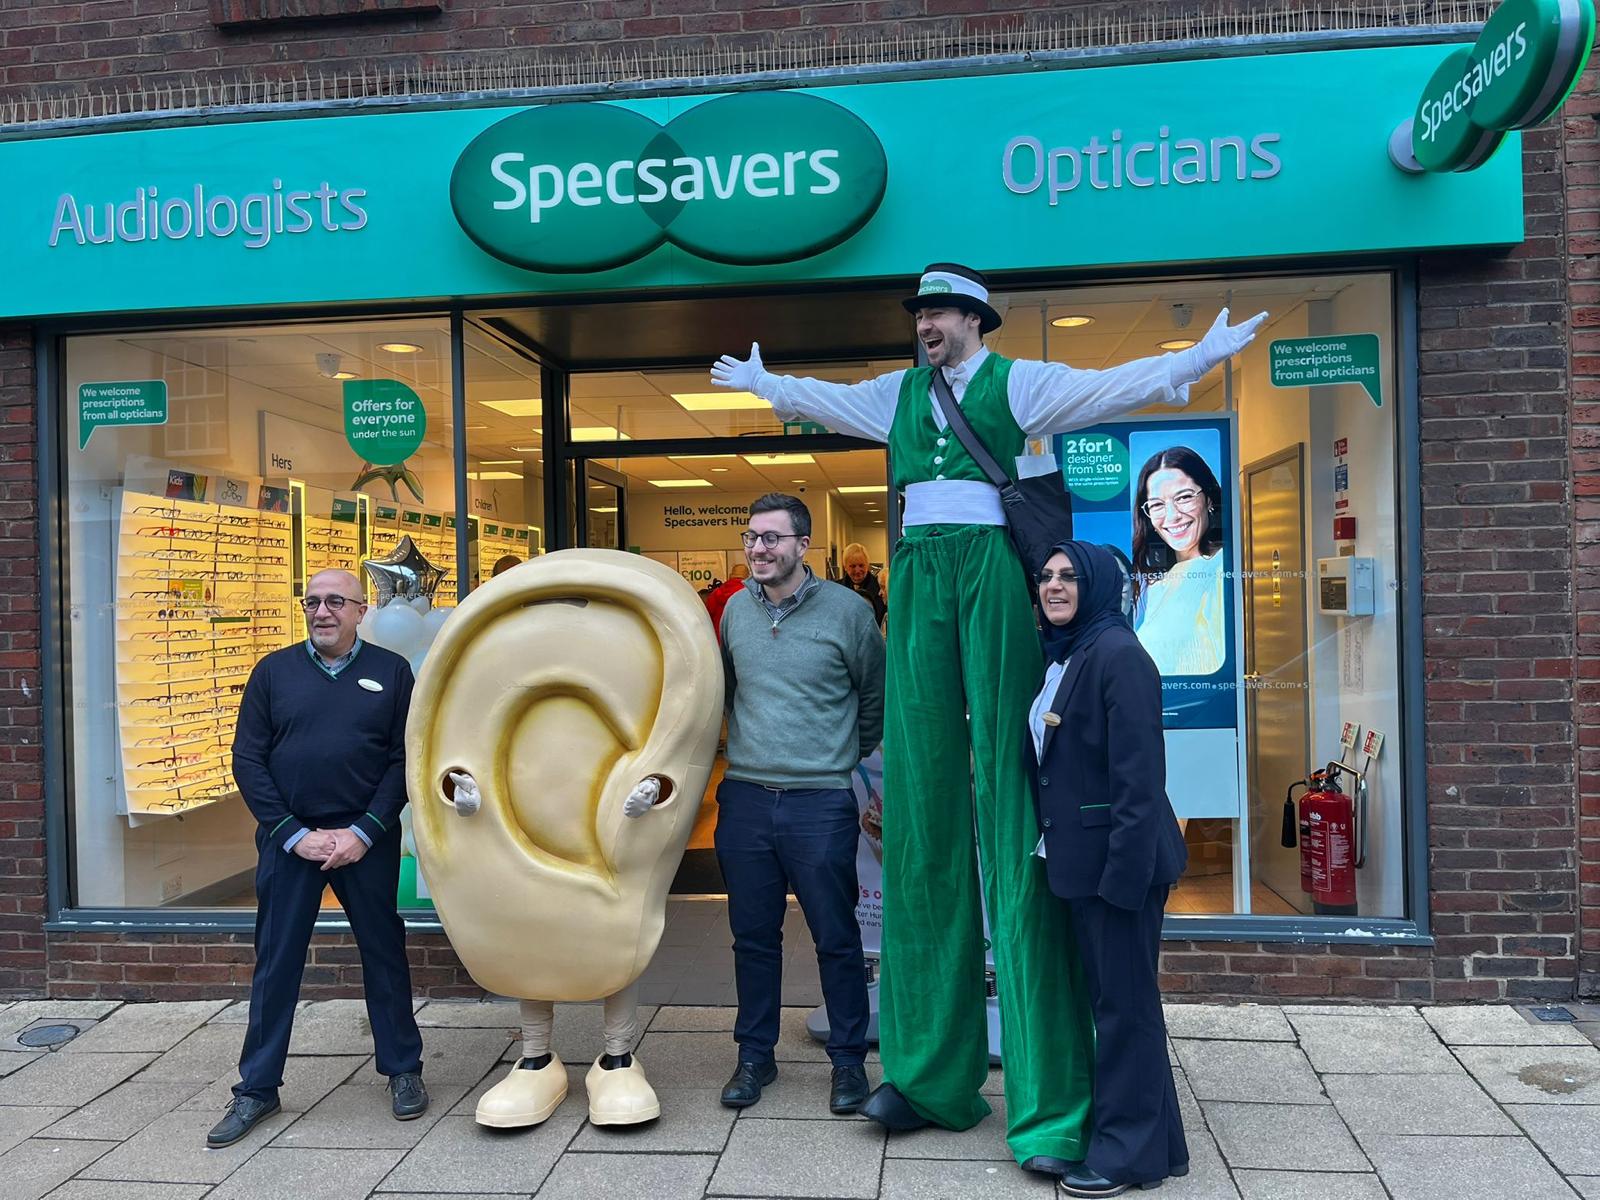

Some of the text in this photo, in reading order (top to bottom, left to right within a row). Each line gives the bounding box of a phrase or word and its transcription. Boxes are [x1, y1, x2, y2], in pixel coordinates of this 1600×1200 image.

[1421, 22, 1526, 142] Specsavers
[1002, 125, 1282, 206] Opticians
[490, 149, 841, 223] Specsavers
[48, 178, 368, 249] Audiologists
[1274, 342, 1347, 354] We welcome
[1275, 353, 1352, 369] prescriptions
[1275, 365, 1375, 380] from all opticians
[82, 387, 141, 397] We welcome
[82, 397, 145, 410] prescriptions
[352, 398, 415, 412] Offers for
[82, 408, 163, 420] from all opticians
[352, 413, 415, 427] everyone
[352, 428, 416, 439] under the sun
[271, 452, 293, 471] Hers
[1067, 454, 1114, 465] designer
[1068, 463, 1122, 475] from £100
[169, 474, 183, 487] Kids
[664, 504, 748, 515] Hello, welcome
[664, 516, 728, 529] Specsavers
[681, 570, 712, 581] £100
[1161, 682, 1210, 690] avers.com
